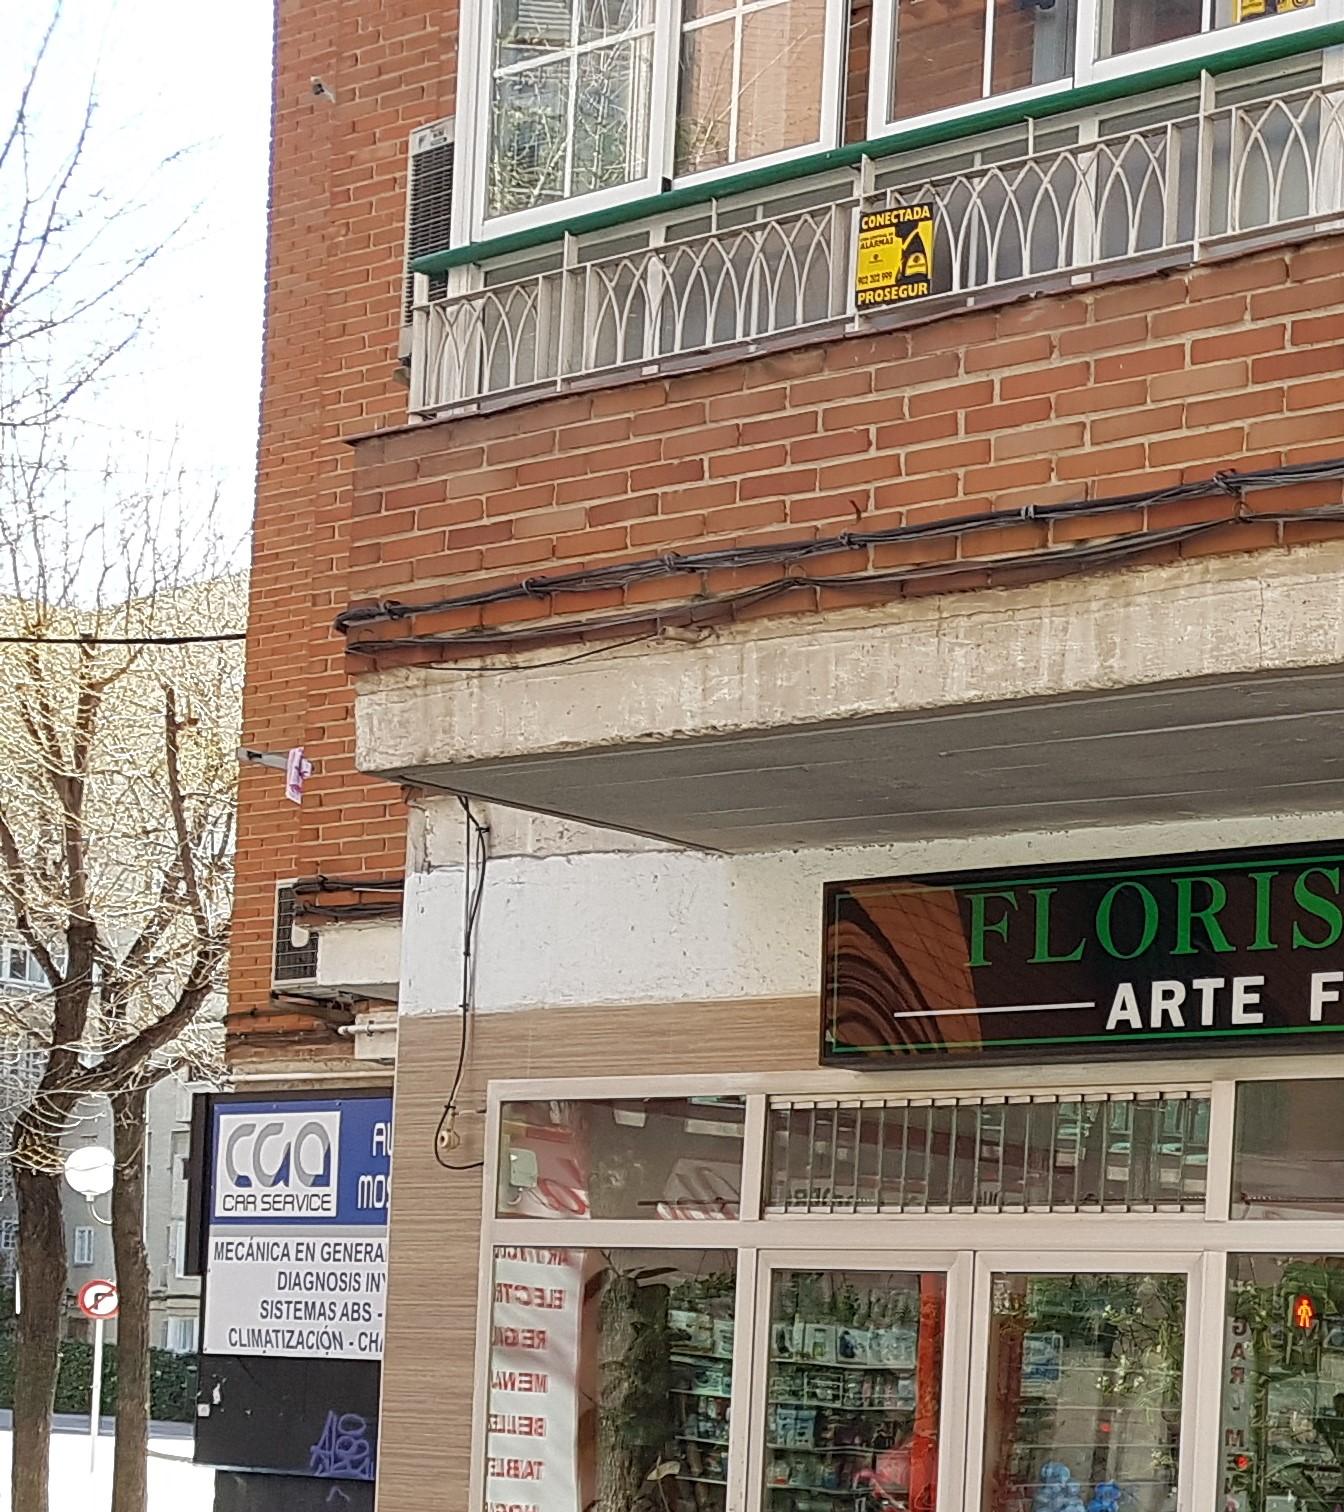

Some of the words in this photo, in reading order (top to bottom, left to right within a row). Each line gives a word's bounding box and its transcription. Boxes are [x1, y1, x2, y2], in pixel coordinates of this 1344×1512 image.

[861, 205, 931, 230] CONECTADA
[857, 282, 928, 306] PROSEGUR
[1105, 974, 1266, 1031] ARTE
[222, 1193, 257, 1212] CAR
[260, 1193, 332, 1212] SERVICE
[213, 1236, 291, 1262] MECÁNICA
[294, 1242, 315, 1262] EN
[320, 1242, 387, 1264] GENERA
[277, 1270, 362, 1293] DIAGNOSIS
[259, 1299, 337, 1322] SISTEMAS
[338, 1301, 373, 1323] ABS
[227, 1325, 344, 1352] CLIMATIZACIÓN
